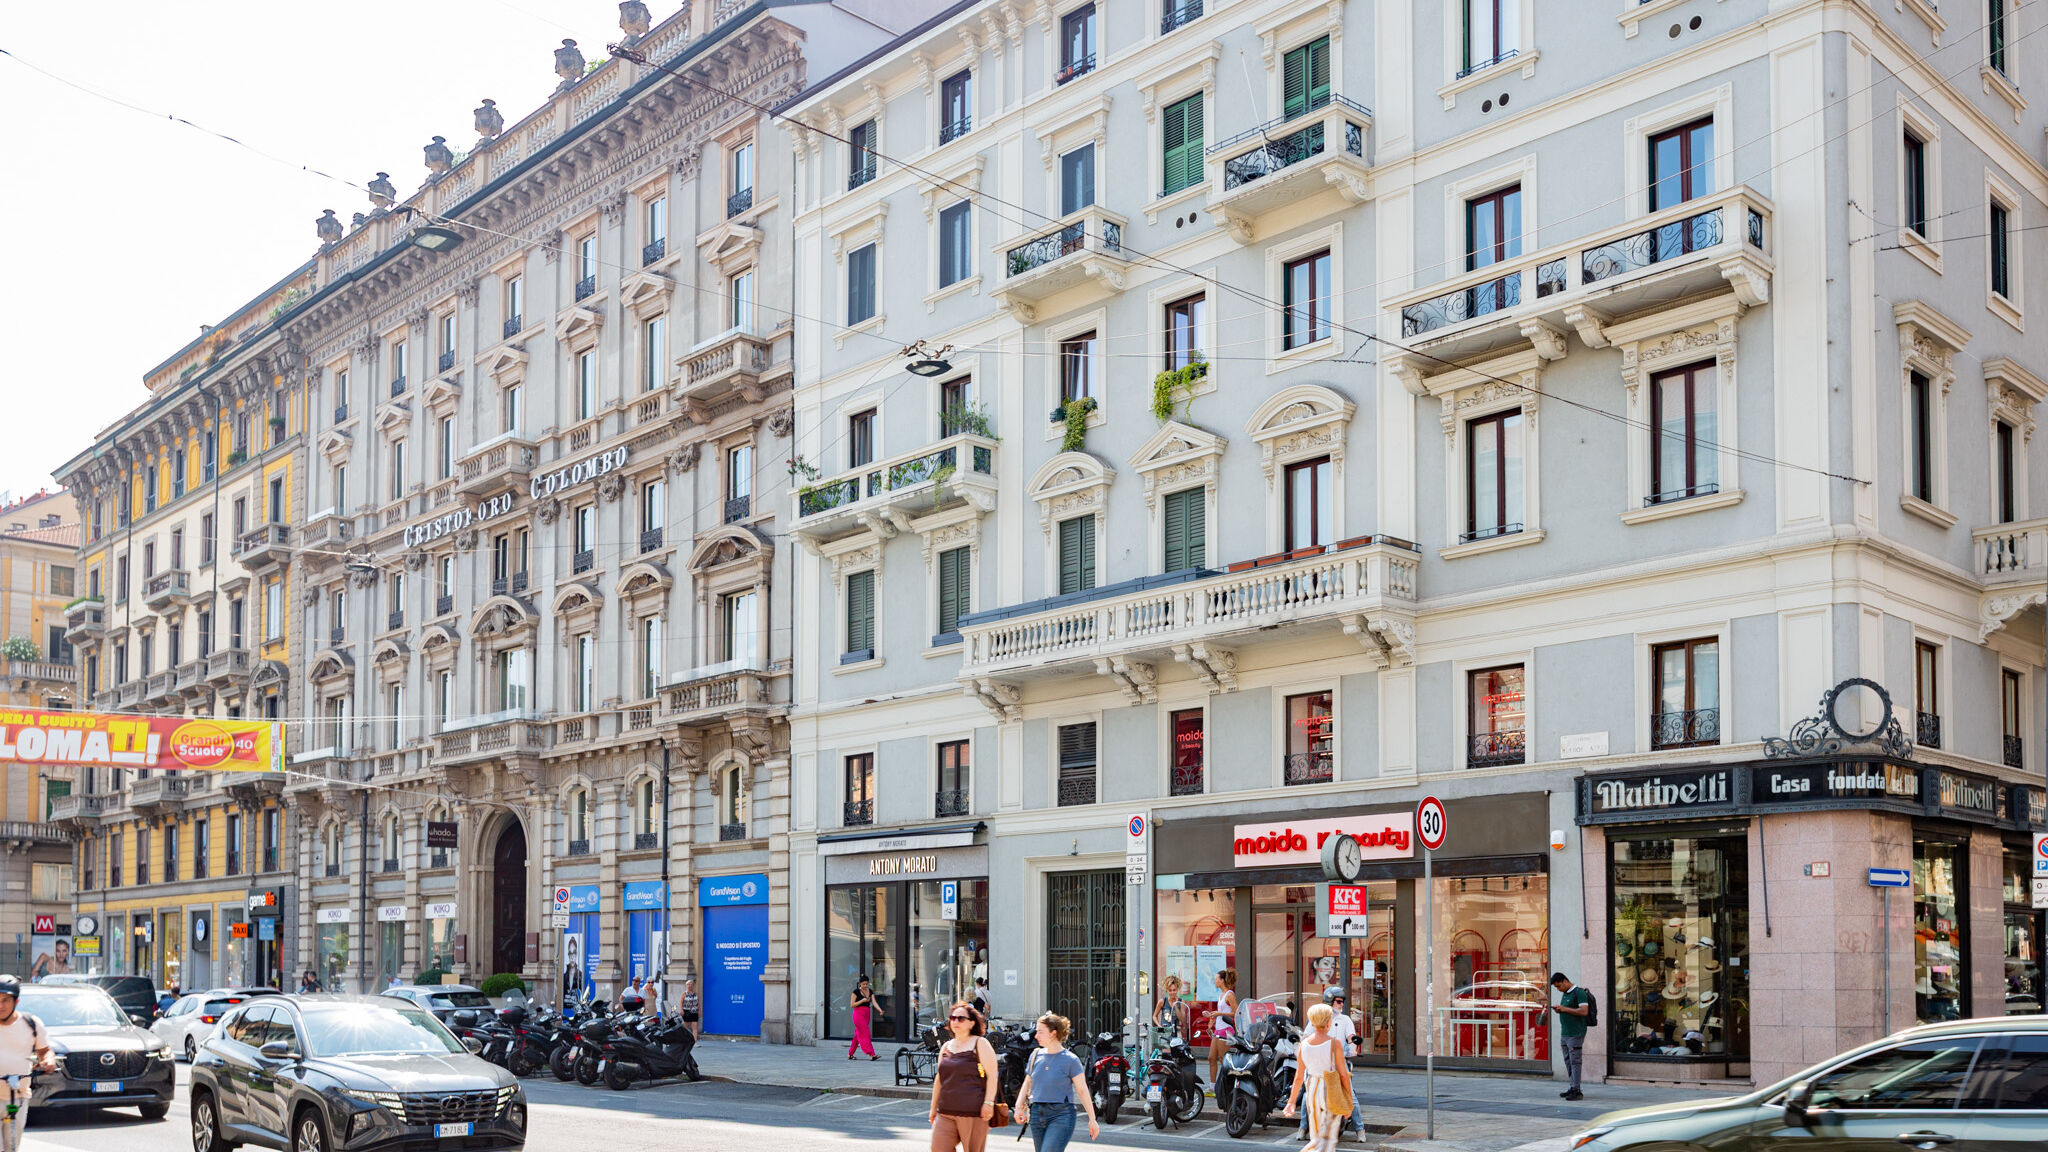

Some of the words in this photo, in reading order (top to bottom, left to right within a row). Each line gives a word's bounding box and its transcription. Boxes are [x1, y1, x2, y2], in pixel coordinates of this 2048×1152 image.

[404, 492, 512, 548] CRISTOFORO
[530, 446, 629, 500] COLOMBO
[1480, 690, 1521, 705] moida
[39, 715, 97, 729] SUBITO
[1296, 712, 1329, 728] moida
[180, 734, 225, 745] Grandi
[235, 739, 254, 750] 40
[178, 744, 224, 757] Scuole
[1771, 774, 1811, 794] Casa
[1827, 769, 1886, 790] fondata
[1596, 772, 1728, 809] Mutinelli
[1940, 774, 1993, 811] Mutinelli
[1424, 810, 1440, 835] 30
[1234, 828, 1308, 855] moida
[869, 857, 901, 876] ANTONY
[903, 855, 937, 874] MORATO
[1333, 888, 1361, 904] KFC
[327, 910, 342, 918] KIKO
[385, 907, 401, 916] KIKO
[433, 904, 450, 914] KIKO
[37, 918, 54, 930] M
[233, 926, 247, 934] TAXI
